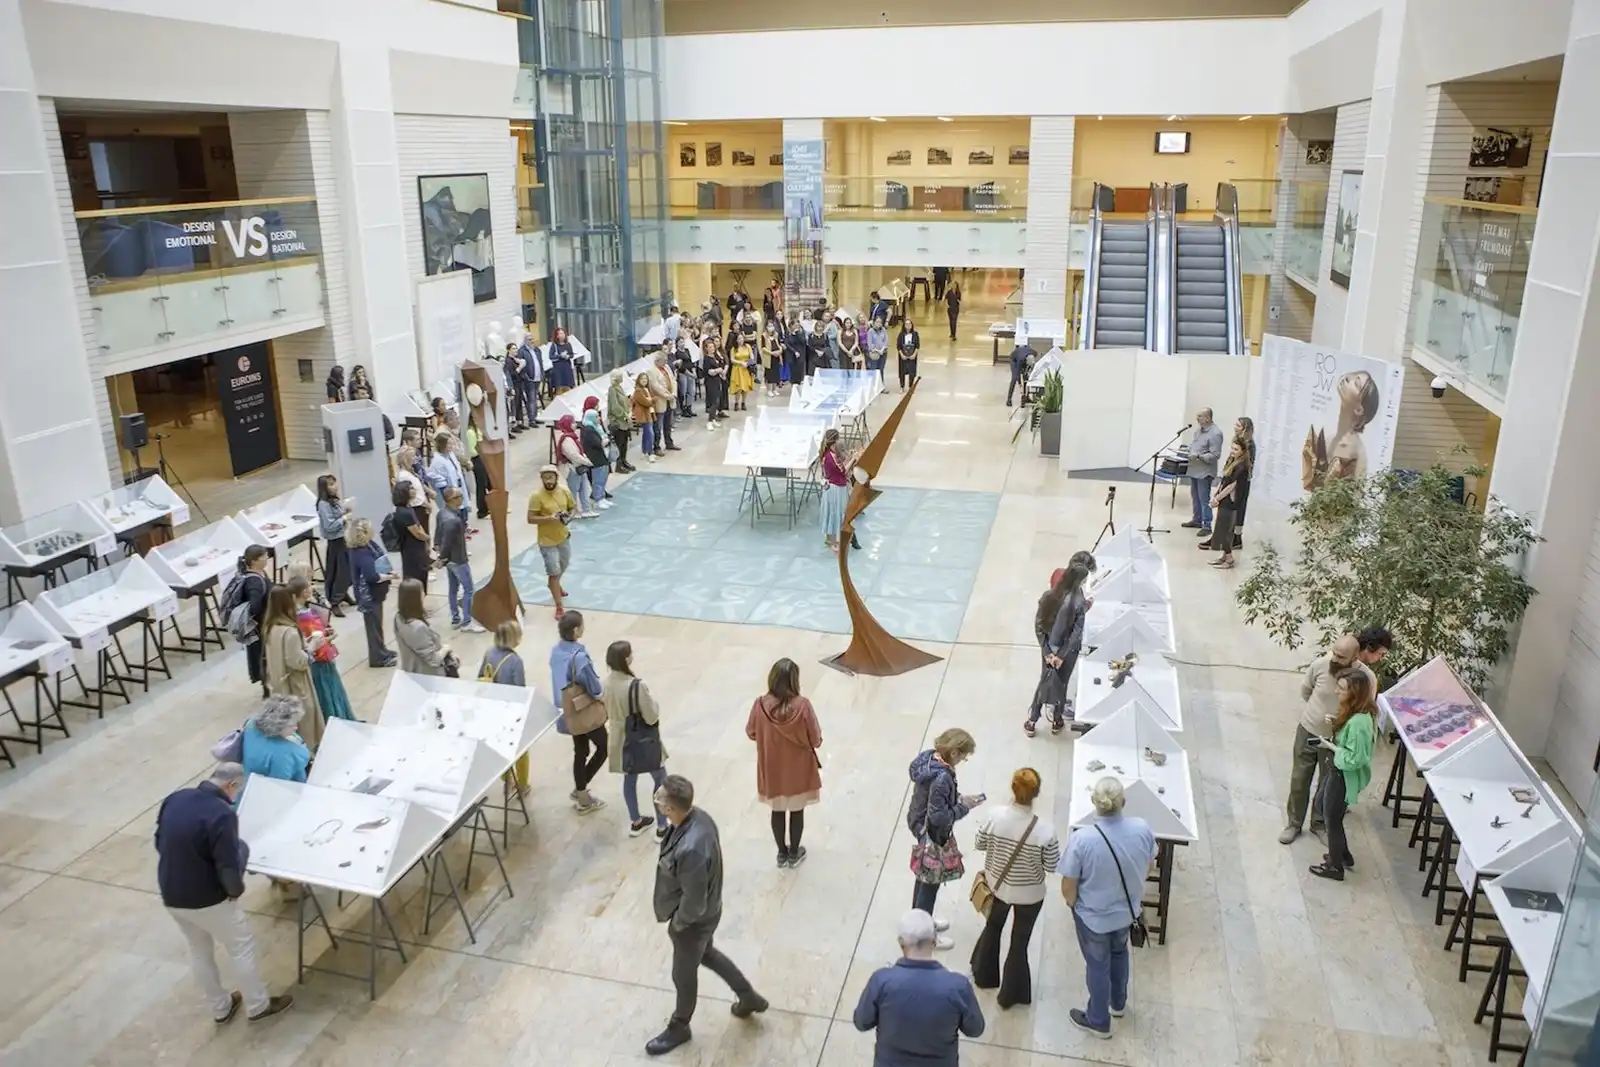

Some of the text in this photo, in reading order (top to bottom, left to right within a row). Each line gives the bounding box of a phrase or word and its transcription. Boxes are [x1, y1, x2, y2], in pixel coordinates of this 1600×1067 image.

[183, 221, 216, 233] DESIGN
[165, 234, 217, 248] EMOTIONAL
[221, 216, 269, 258] VS
[270, 230, 297, 241] DESIGN
[271, 242, 306, 254] RATIONAL
[230, 372, 262, 388] EUROINS
